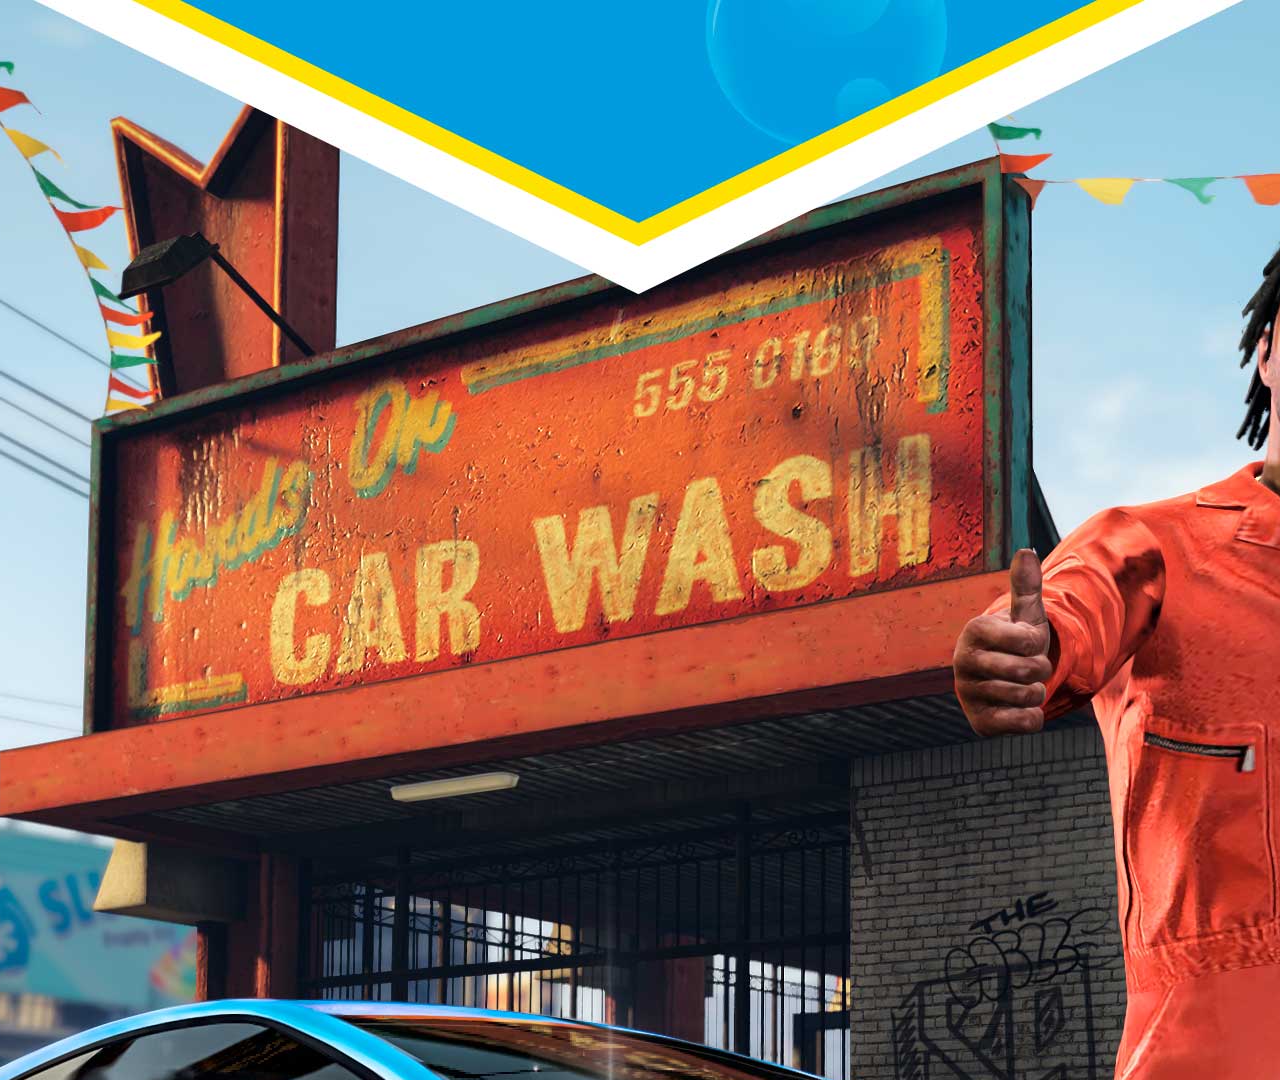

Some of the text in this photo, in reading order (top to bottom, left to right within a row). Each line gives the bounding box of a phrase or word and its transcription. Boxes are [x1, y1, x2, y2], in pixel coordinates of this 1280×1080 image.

[633, 349, 732, 417] 555
[120, 378, 458, 636] Hands On
[269, 432, 933, 685] CAR WASH
[970, 891, 1060, 934] THE
